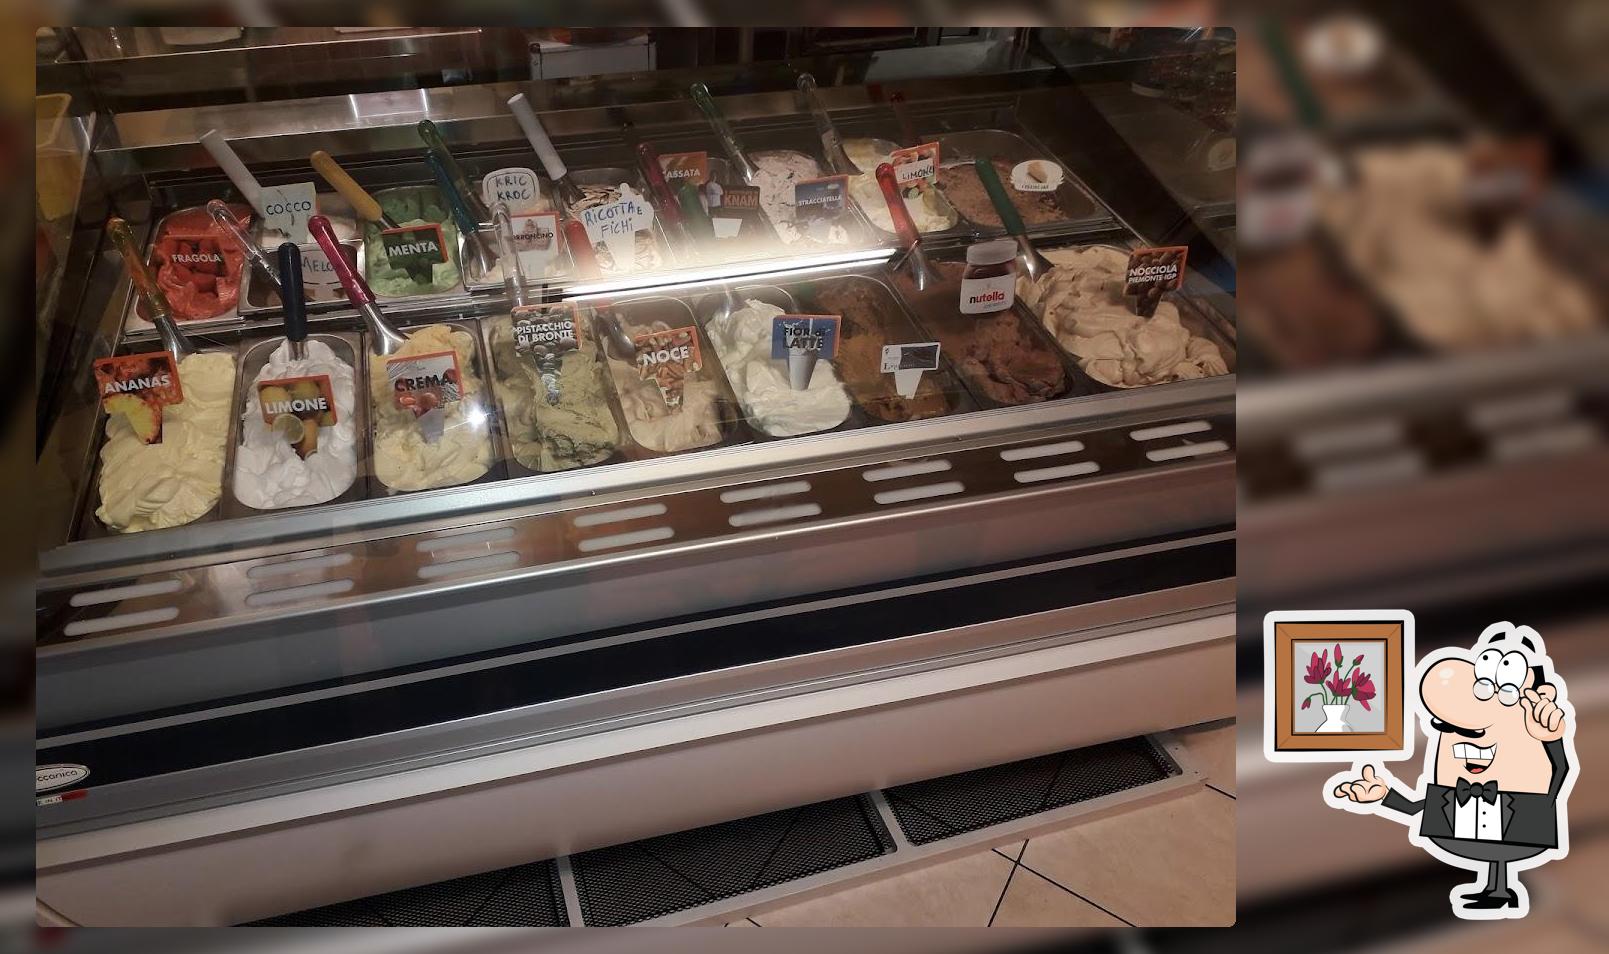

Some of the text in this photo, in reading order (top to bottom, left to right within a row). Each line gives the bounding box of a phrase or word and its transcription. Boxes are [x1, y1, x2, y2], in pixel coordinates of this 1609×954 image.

[266, 201, 311, 215] COCCO
[388, 241, 438, 257] MENTA
[171, 253, 222, 263] FRAGOLA
[1129, 264, 1178, 277] NOCCIOLA
[1128, 273, 1177, 284] PIEMONTE IGP
[970, 291, 1005, 304] nutella
[516, 320, 573, 335] PISTACCHIO
[518, 329, 574, 344] DI BRONTE
[783, 336, 824, 349] LATTE
[642, 345, 689, 367] NOCE
[104, 374, 170, 394] ANANAS
[394, 373, 454, 392] CREMA
[264, 397, 328, 415] LIMONE
